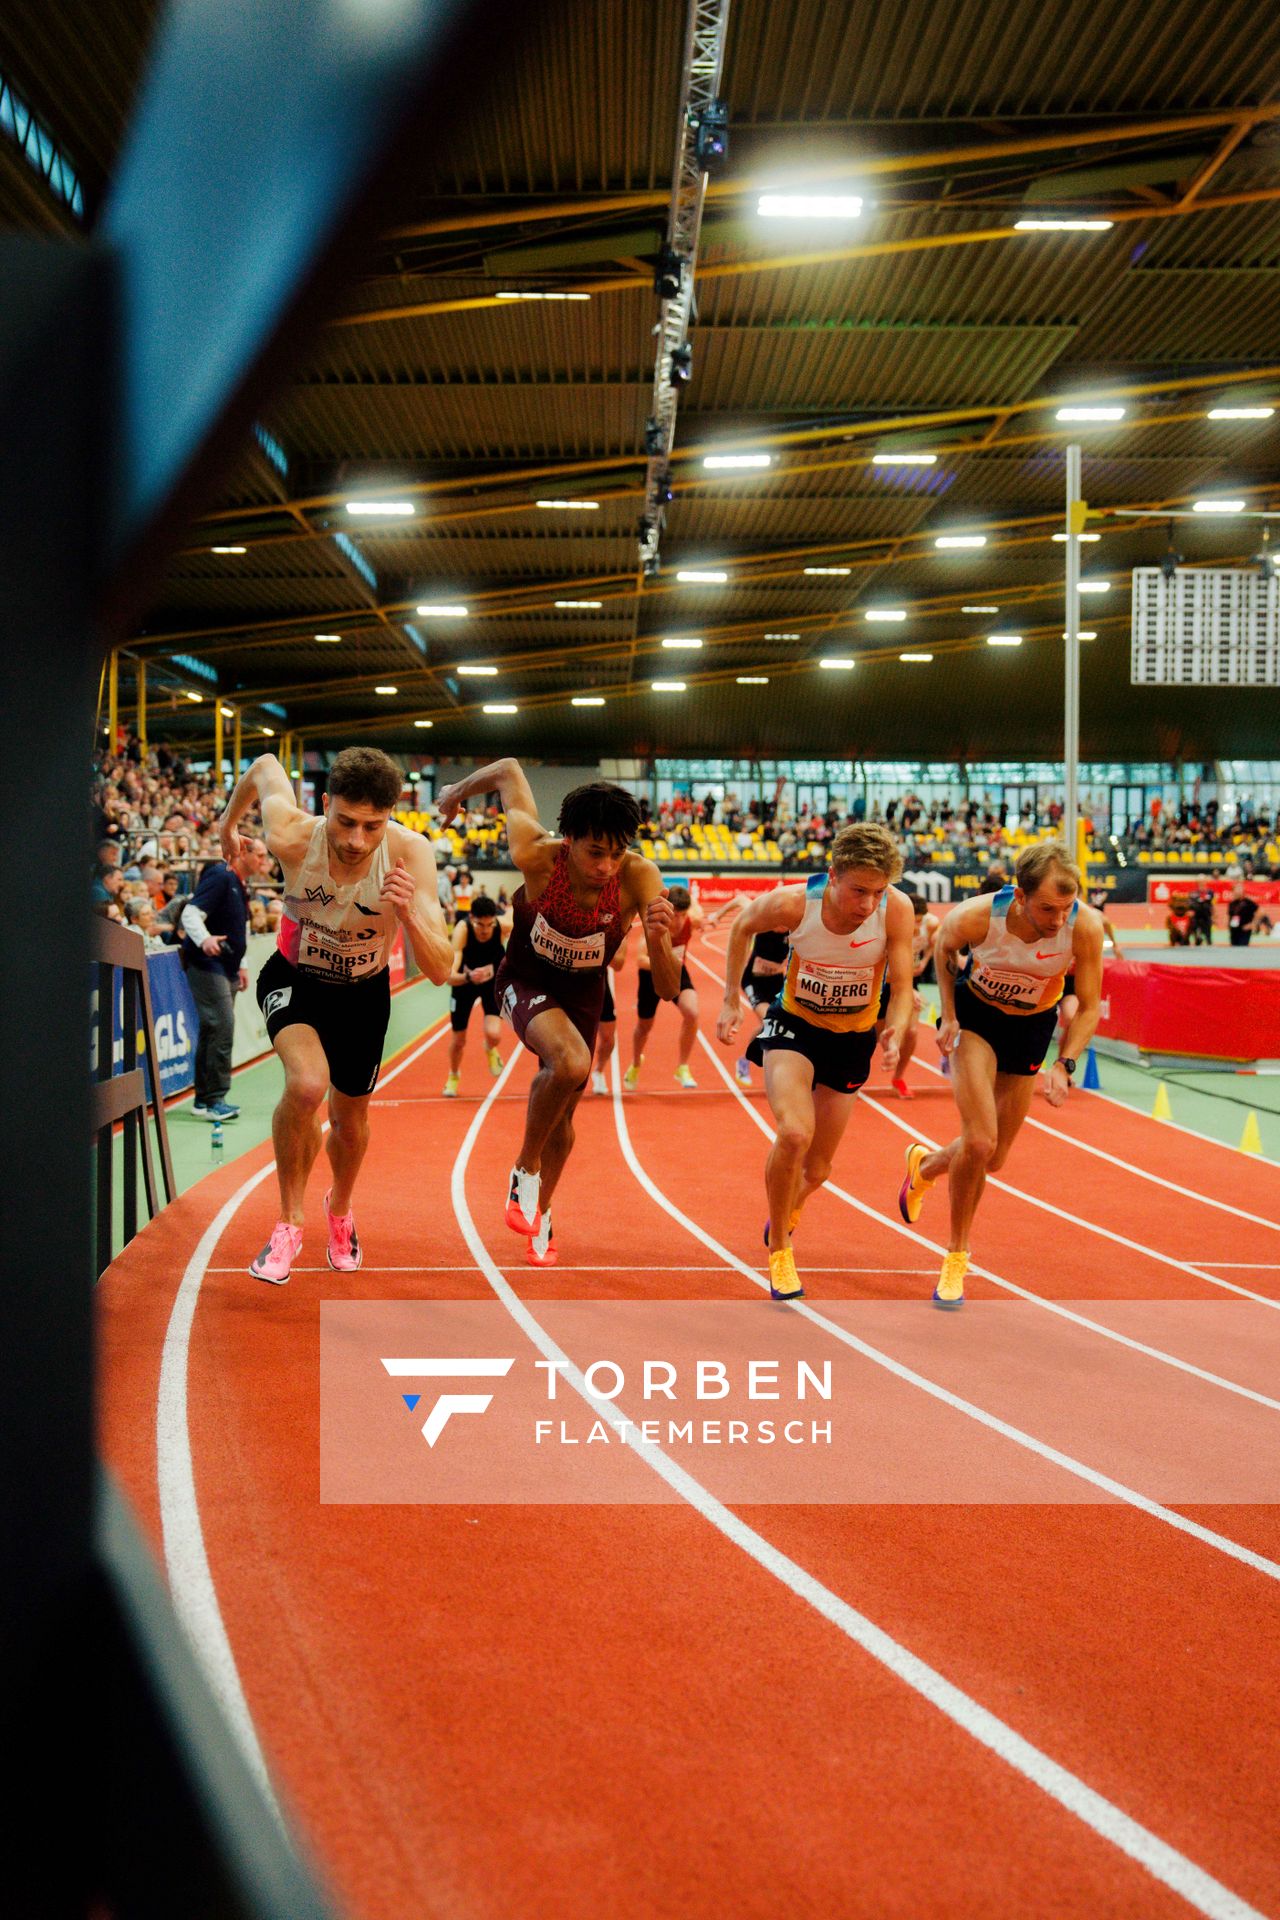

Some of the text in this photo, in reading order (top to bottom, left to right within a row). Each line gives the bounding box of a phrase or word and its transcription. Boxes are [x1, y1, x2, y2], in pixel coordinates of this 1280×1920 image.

[533, 930, 600, 961] VERMEULEN
[307, 945, 378, 968] PROBST
[553, 954, 574, 967] 198
[801, 977, 868, 998] MOE BERG
[822, 997, 843, 1006] 124
